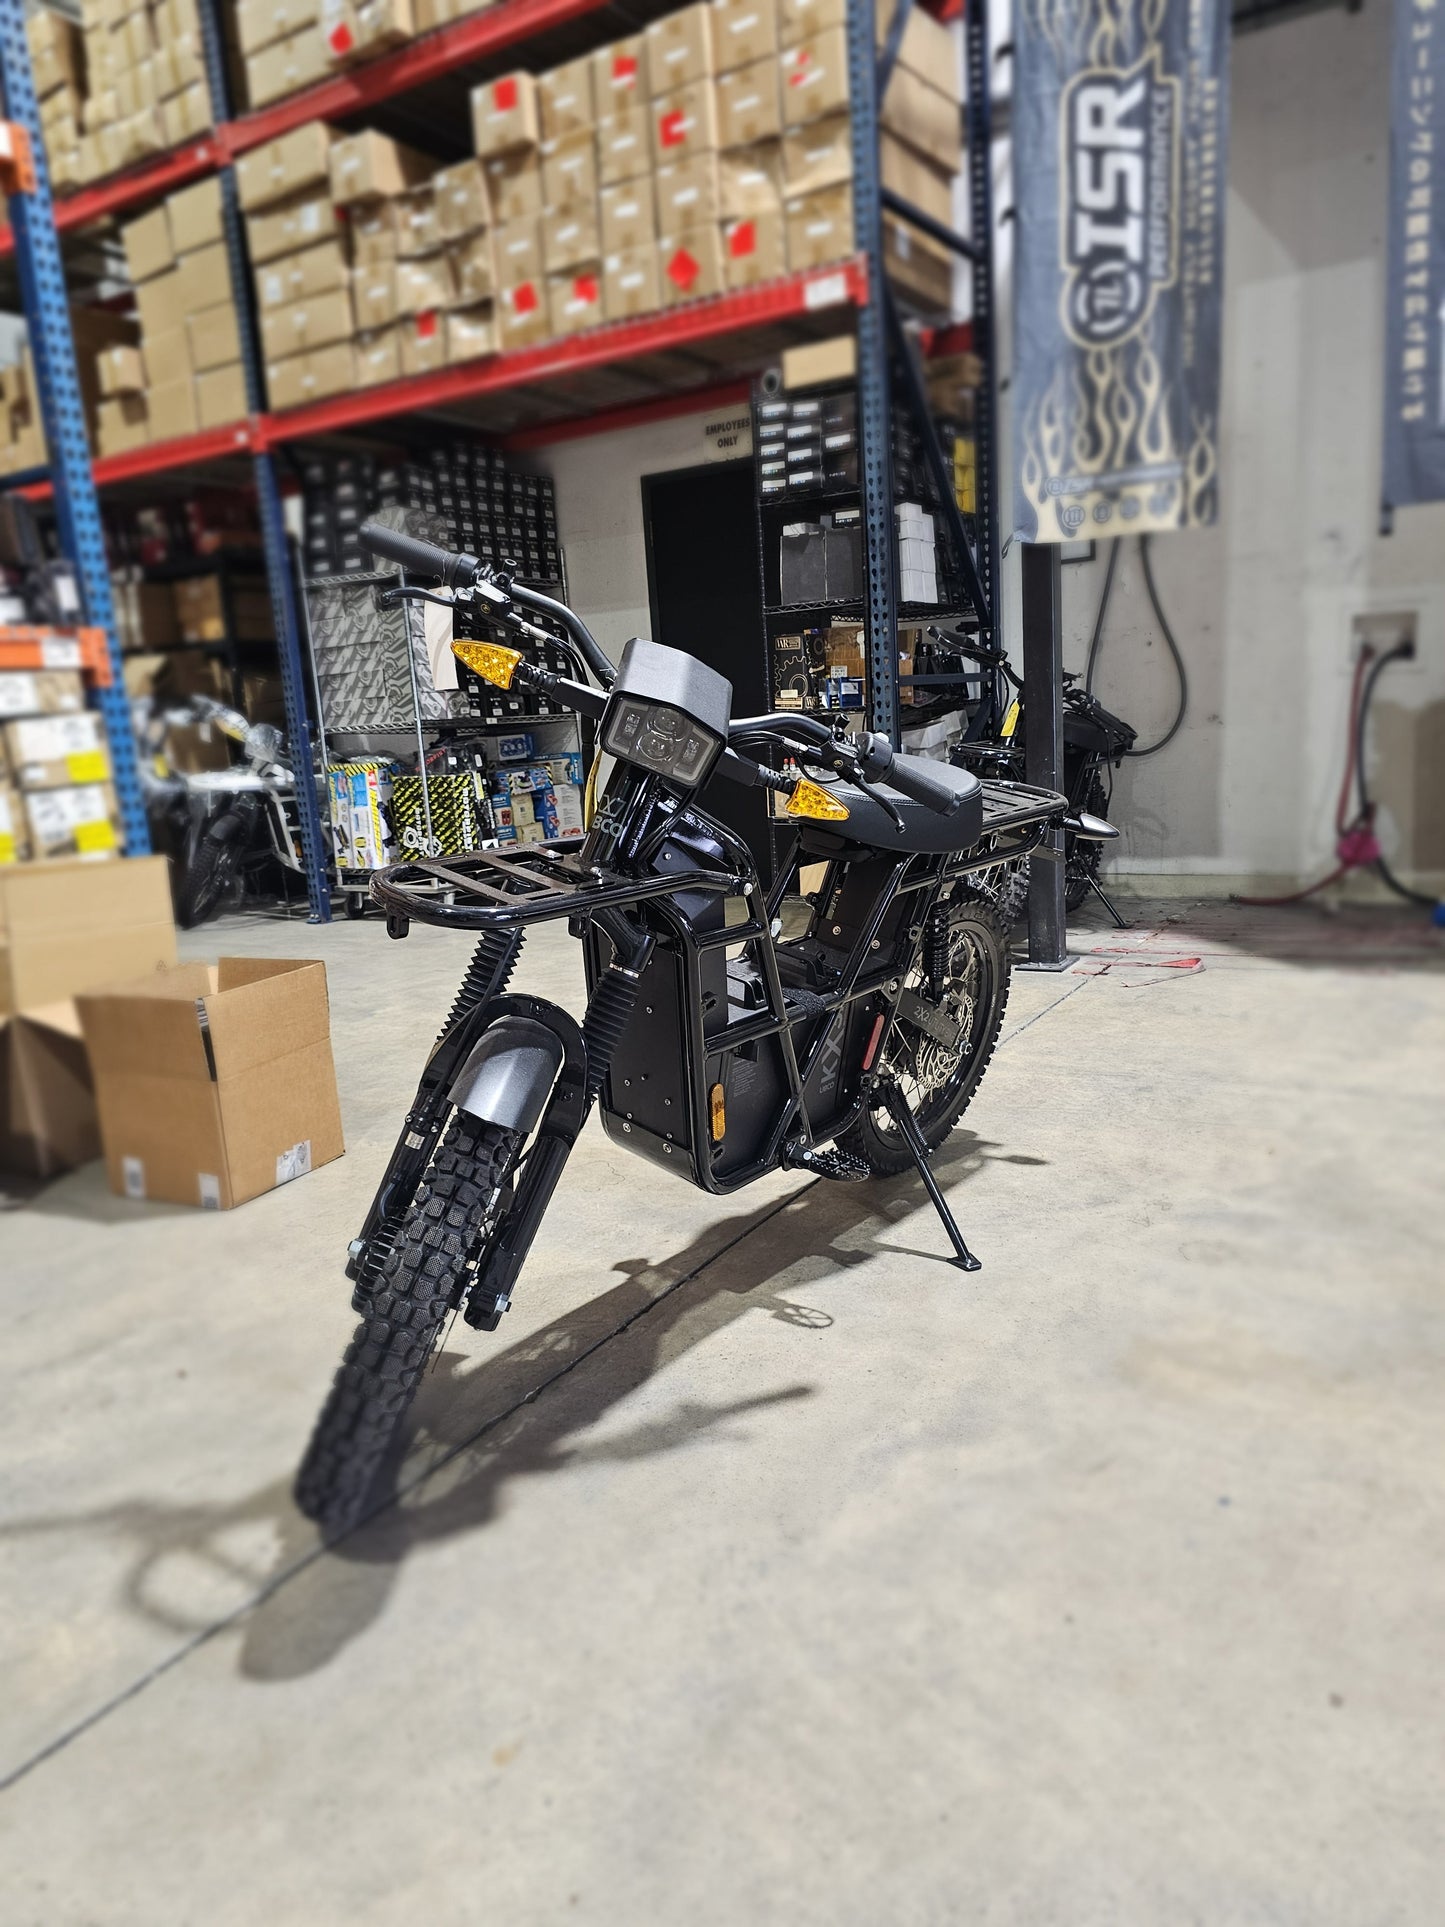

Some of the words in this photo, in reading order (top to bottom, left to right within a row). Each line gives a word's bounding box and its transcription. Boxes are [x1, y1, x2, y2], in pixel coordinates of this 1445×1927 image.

[1076, 78, 1146, 262] ISR
[1150, 88, 1170, 277] PERFORMANCE
[706, 417, 750, 436] EMPLOYEES
[717, 435, 738, 448] ONLY
[592, 815, 623, 838] BCO
